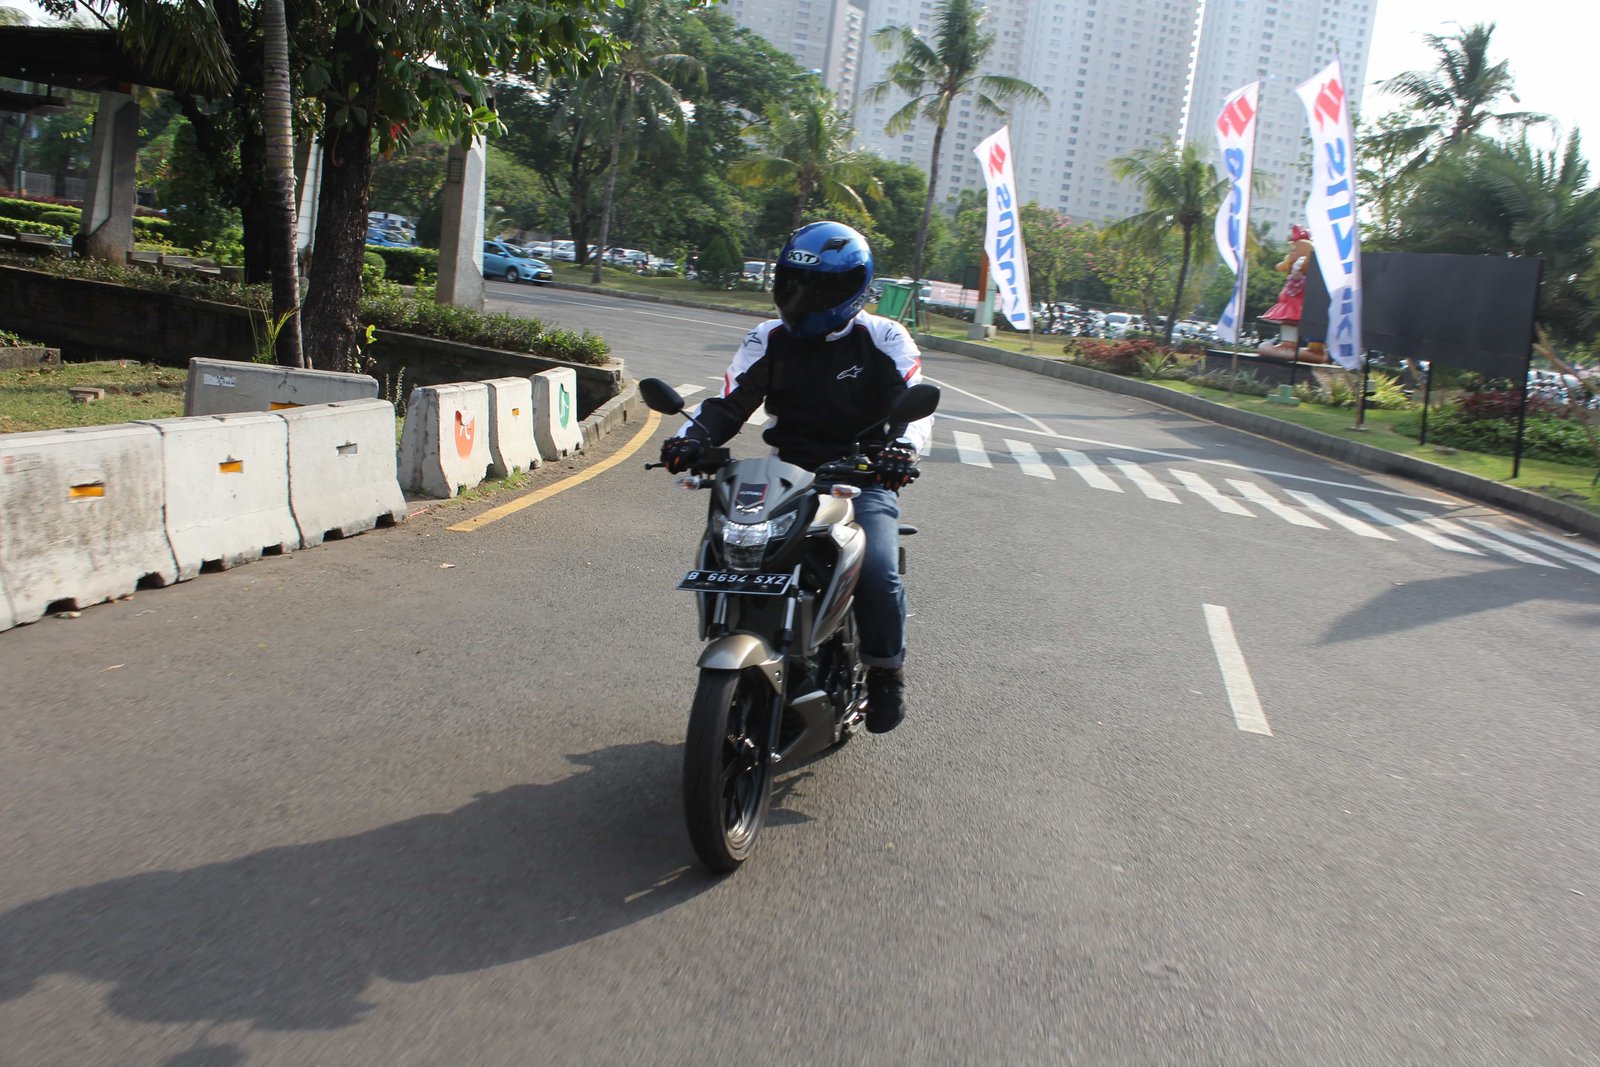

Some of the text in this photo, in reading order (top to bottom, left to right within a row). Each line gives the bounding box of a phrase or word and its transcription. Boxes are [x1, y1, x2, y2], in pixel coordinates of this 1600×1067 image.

[688, 571, 786, 584] B 6694 SXZ
